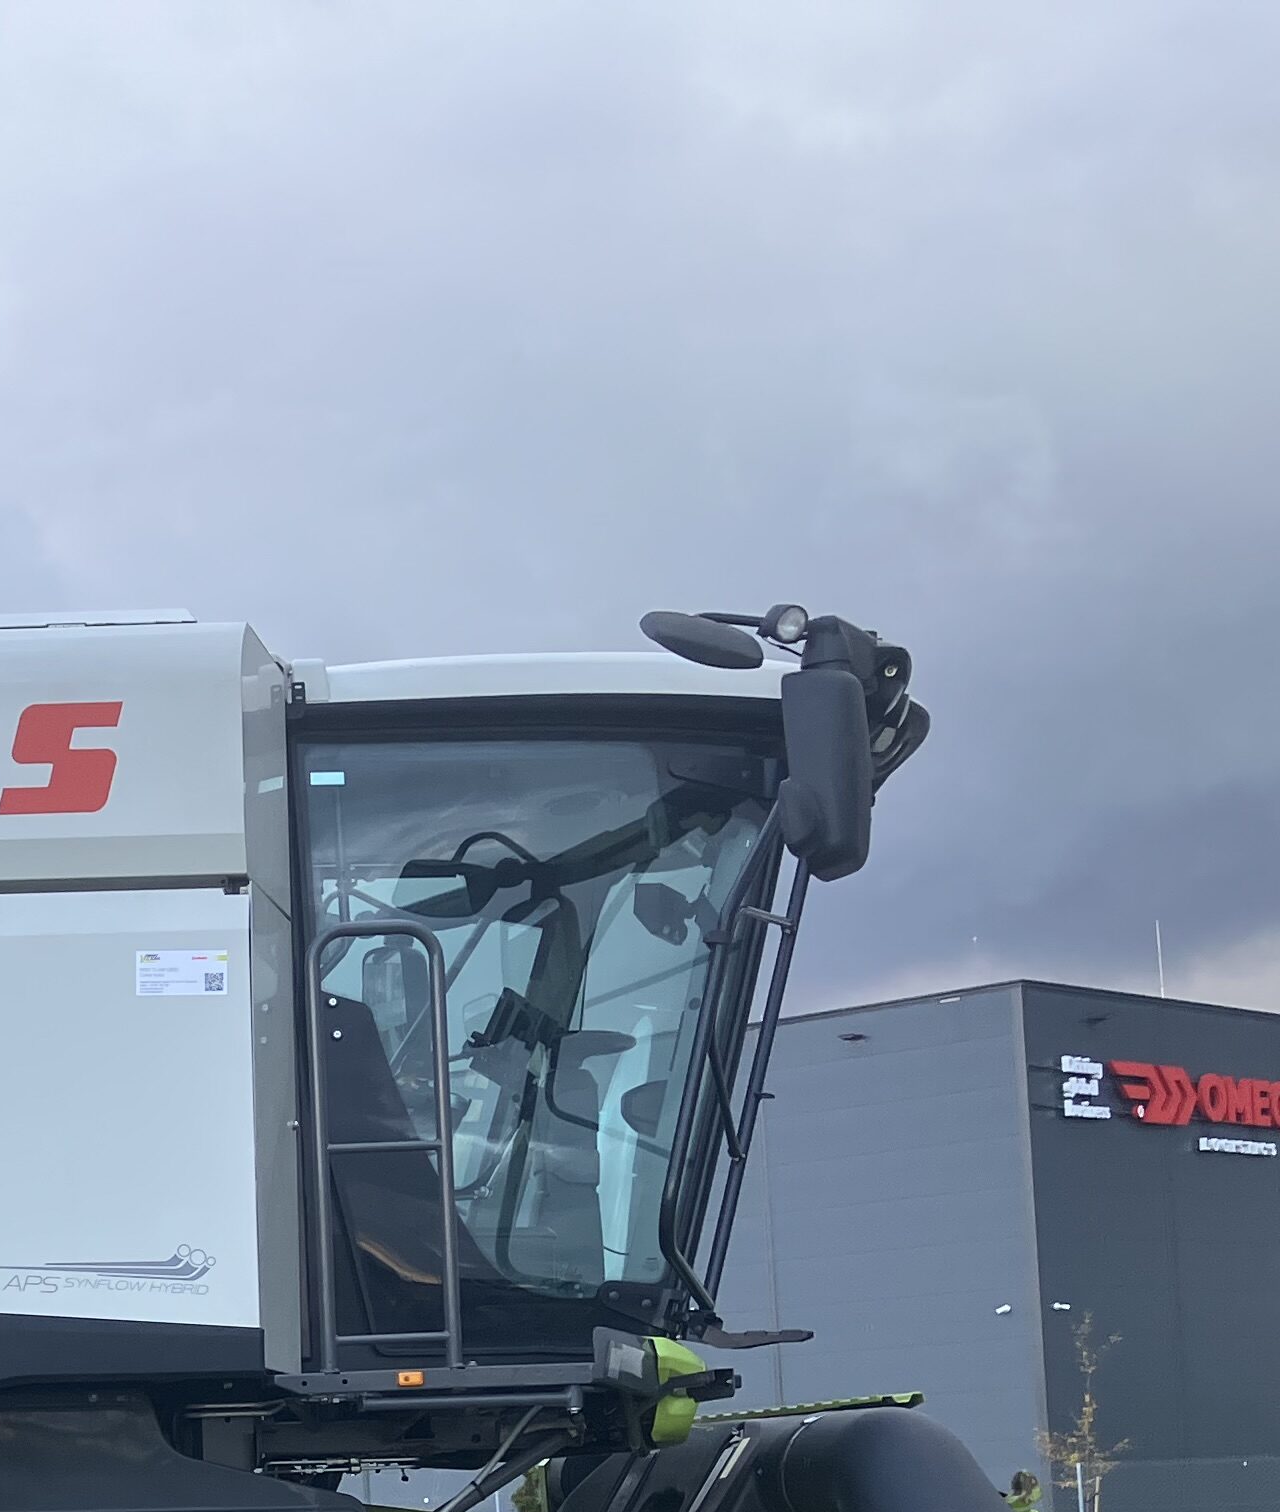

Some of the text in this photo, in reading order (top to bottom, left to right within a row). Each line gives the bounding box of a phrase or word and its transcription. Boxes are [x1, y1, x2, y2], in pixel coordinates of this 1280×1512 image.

[2, 1274, 210, 1296] APS SYNFLOW HYBRID
